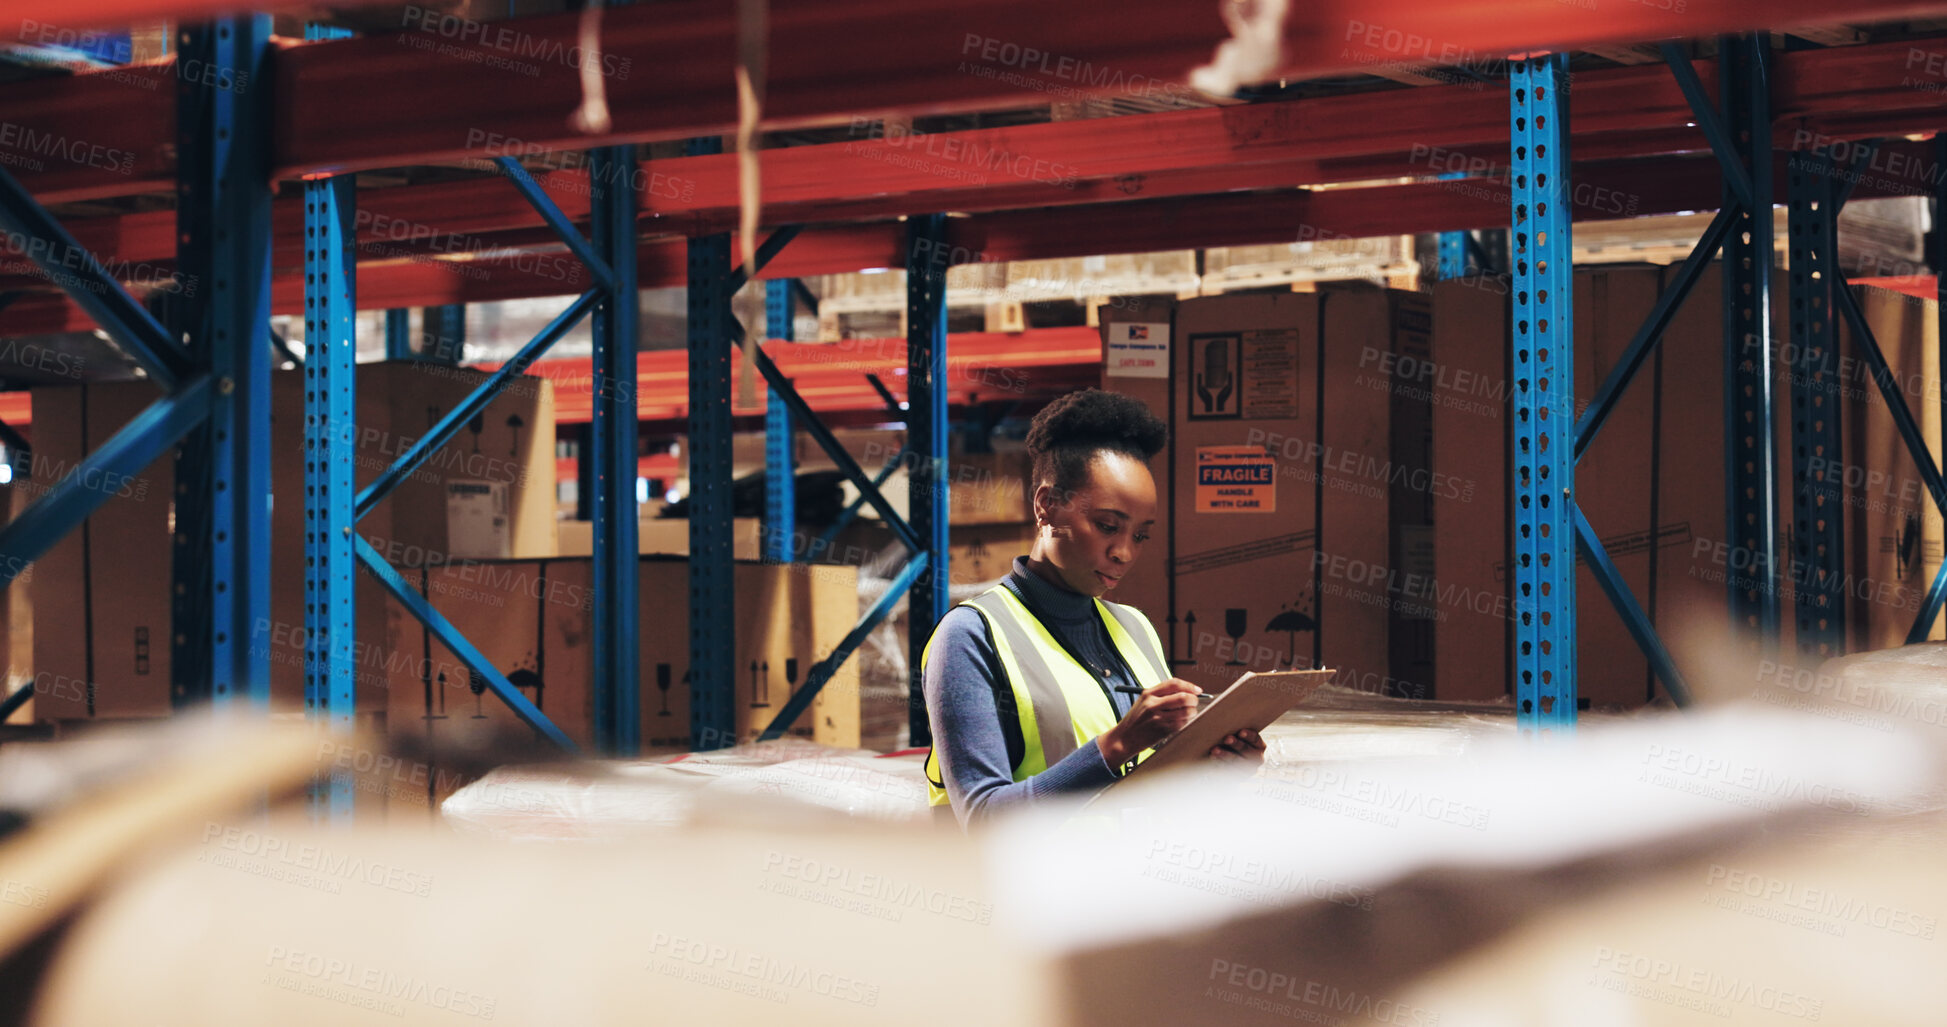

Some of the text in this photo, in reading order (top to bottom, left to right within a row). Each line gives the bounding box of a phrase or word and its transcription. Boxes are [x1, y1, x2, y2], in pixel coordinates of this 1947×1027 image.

[1203, 468, 1269, 481] FRAGILE
[1217, 488, 1254, 496] HANDLE
[1236, 500, 1260, 508] CARE
